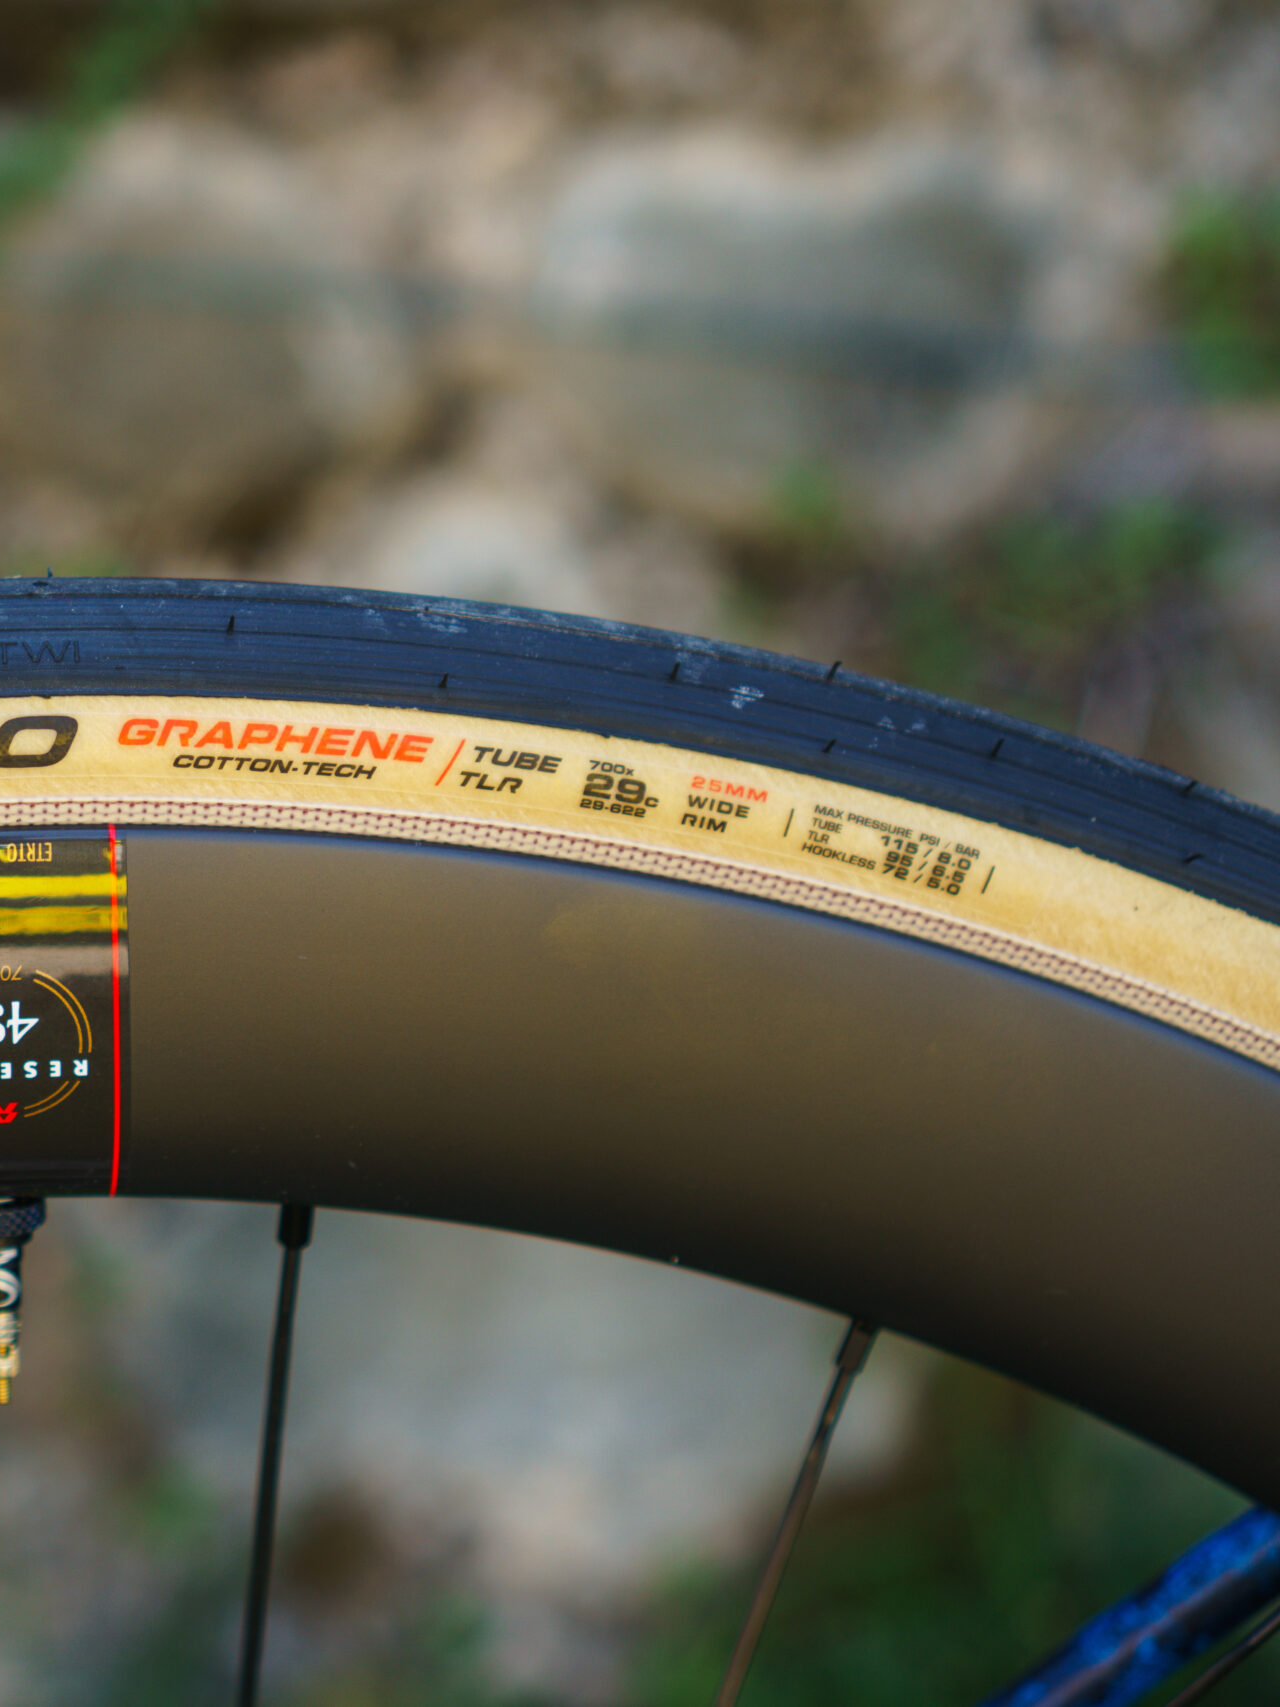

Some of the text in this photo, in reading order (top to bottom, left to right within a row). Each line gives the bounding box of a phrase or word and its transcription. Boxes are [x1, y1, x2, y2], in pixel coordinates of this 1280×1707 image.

[117, 718, 434, 763] GRAPHENE
[172, 754, 378, 780] COTTON-TECH
[473, 745, 563, 774] TUBE
[588, 759, 636, 777] 700x
[460, 770, 524, 794] TLR
[691, 775, 769, 804] 25MM
[579, 798, 647, 818] 29-622
[687, 794, 751, 819] WIDE
[681, 813, 728, 833] RIM
[814, 804, 845, 820] MAX
[847, 812, 913, 839] PRESSURE
[919, 832, 941, 847] PSI
[954, 843, 981, 860] BAR
[6, 841, 53, 863] ETRTO
[808, 830, 831, 845] TLR
[885, 850, 914, 867] 95
[931, 864, 967, 884] 6.5
[812, 817, 844, 834] TUBE
[881, 835, 920, 855] 115
[937, 851, 972, 871] 8.0
[801, 842, 877, 871] HOOKLESS
[881, 862, 910, 880] 72
[926, 876, 961, 896] 5.0
